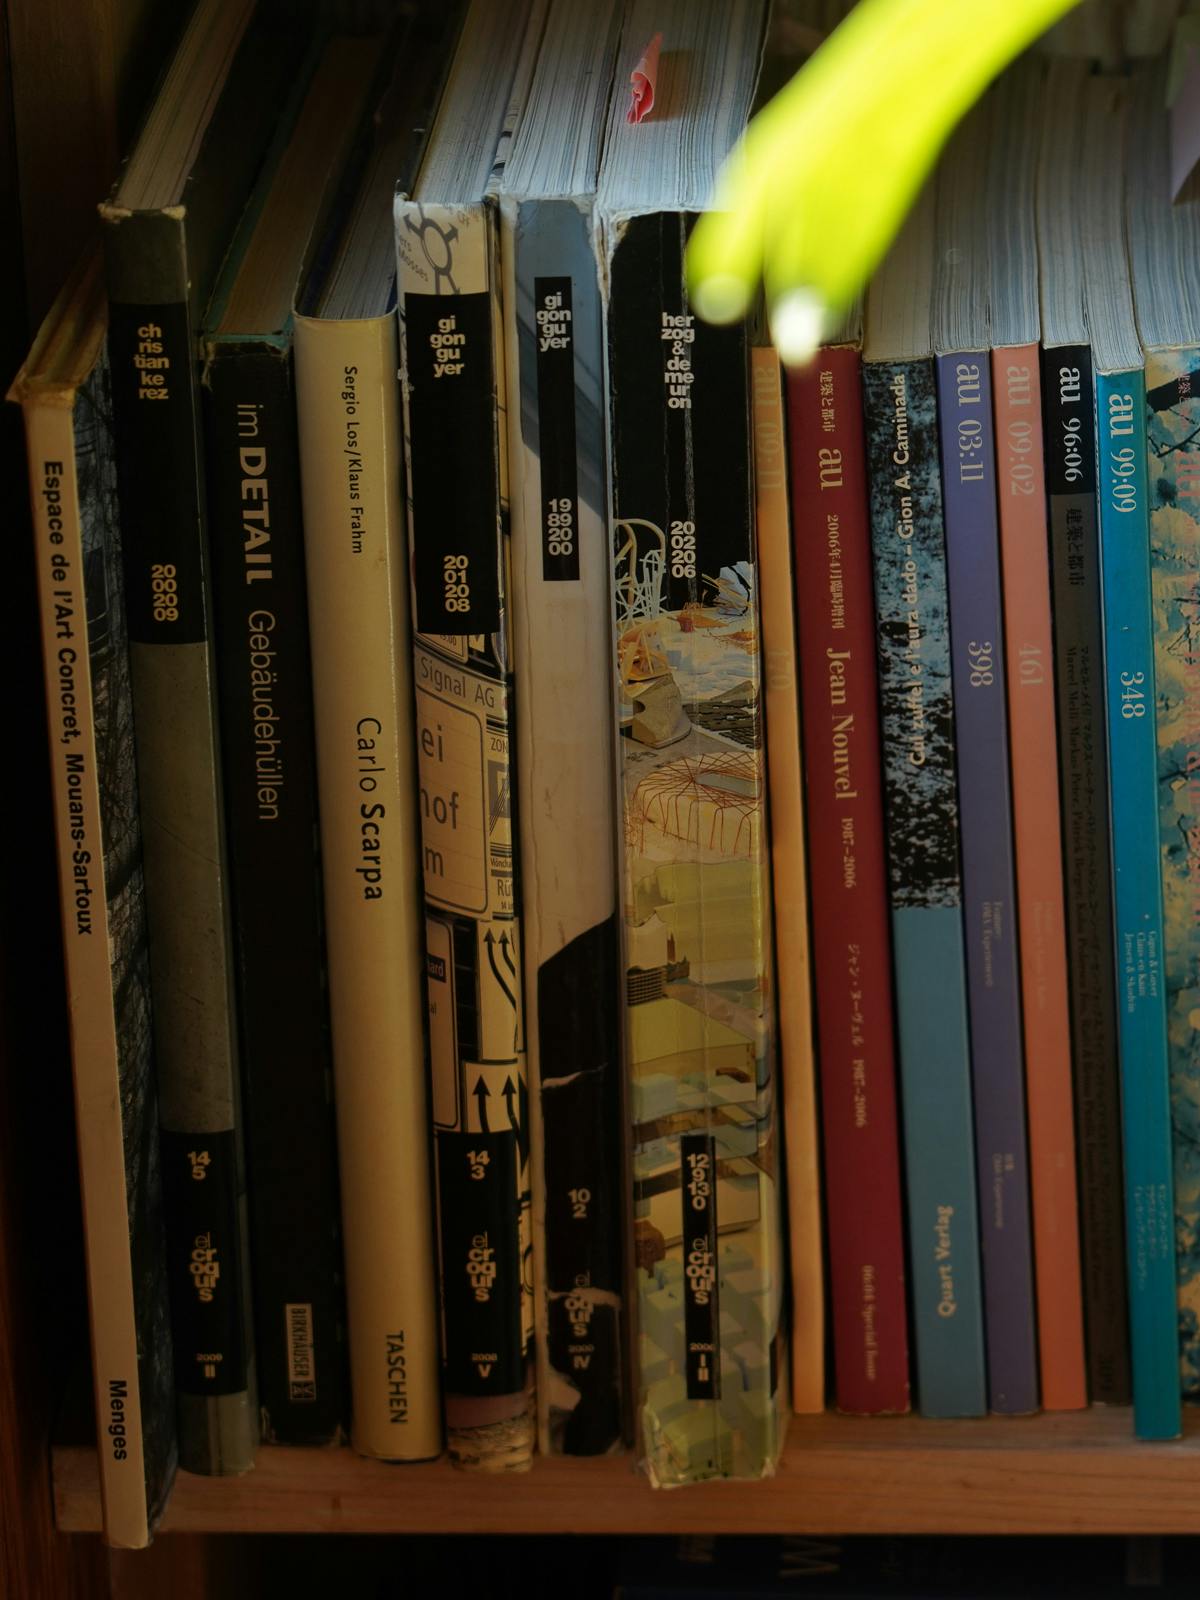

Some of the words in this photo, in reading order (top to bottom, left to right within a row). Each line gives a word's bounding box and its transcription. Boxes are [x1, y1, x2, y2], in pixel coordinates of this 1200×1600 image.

[236, 402, 264, 437] im
[345, 366, 358, 415] Sergio
[890, 373, 911, 465] Caminada
[345, 422, 362, 501] Los/Klaus
[958, 419, 984, 484] 03:11
[1008, 420, 1035, 496] 09:02
[1062, 416, 1084, 483] 96:06
[44, 461, 64, 545] Espace
[894, 470, 912, 491] A.
[1110, 448, 1137, 514] 99:09
[240, 446, 273, 585] DETAIL
[350, 507, 363, 555] Frahm
[897, 496, 915, 539] Gion
[51, 554, 69, 582] de
[900, 560, 919, 605] dado
[54, 590, 75, 638] l'Art
[420, 656, 466, 699] Signal
[475, 687, 496, 709] AG
[826, 648, 852, 706] Jean
[911, 664, 922, 675] e
[967, 640, 993, 688] 398
[1018, 643, 1042, 687] 461
[59, 648, 83, 745] Concret,
[247, 608, 281, 821] Gebäudehüllen
[1121, 671, 1146, 719] 348
[356, 717, 385, 792] Carlo
[421, 724, 443, 763] ei
[830, 713, 858, 800] Nouvel
[66, 753, 94, 936] Mouans-Sartoux
[356, 803, 386, 901] Scarpa
[936, 1205, 955, 1260] Verlag
[937, 1264, 957, 1317] Quart
[384, 1330, 407, 1425] TASCHEN
[108, 1379, 129, 1462] Menges
